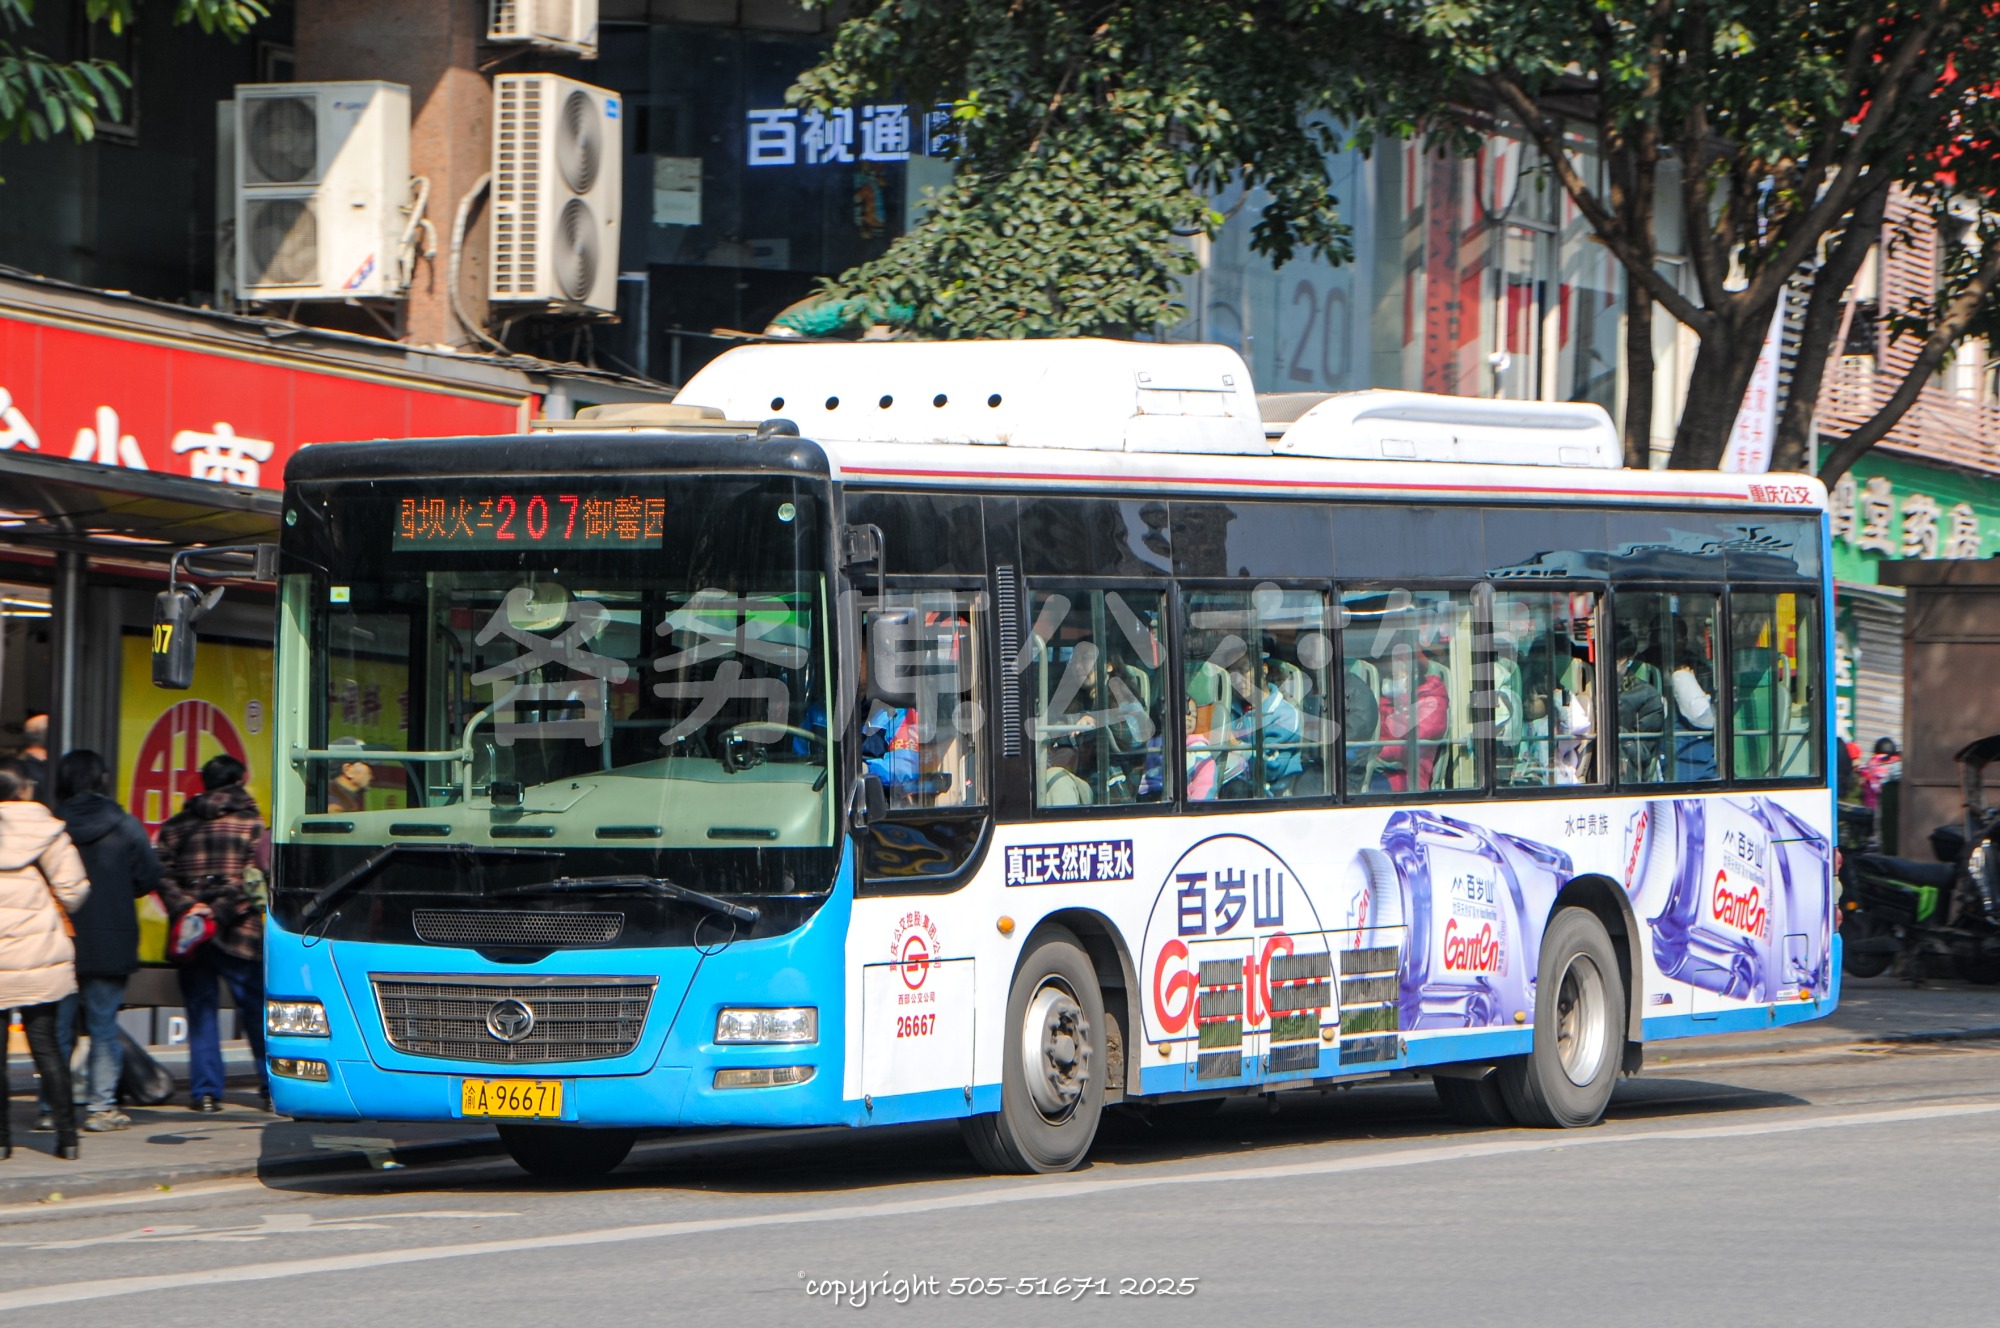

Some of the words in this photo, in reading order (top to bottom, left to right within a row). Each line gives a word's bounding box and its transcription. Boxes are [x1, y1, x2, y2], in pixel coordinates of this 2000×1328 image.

[746, 104, 910, 166] 百视通
[1748, 484, 1813, 505] 重庆公交
[496, 495, 578, 540] 207
[152, 624, 173, 655] 07
[1564, 812, 1609, 837] 水中贵族
[1006, 844, 1133, 885] 真正天然矿泉水
[1176, 867, 1284, 936] 百岁山
[1467, 873, 1494, 904] 百岁山
[898, 991, 936, 1005] 西部公交公司
[896, 1013, 936, 1038] 26667
